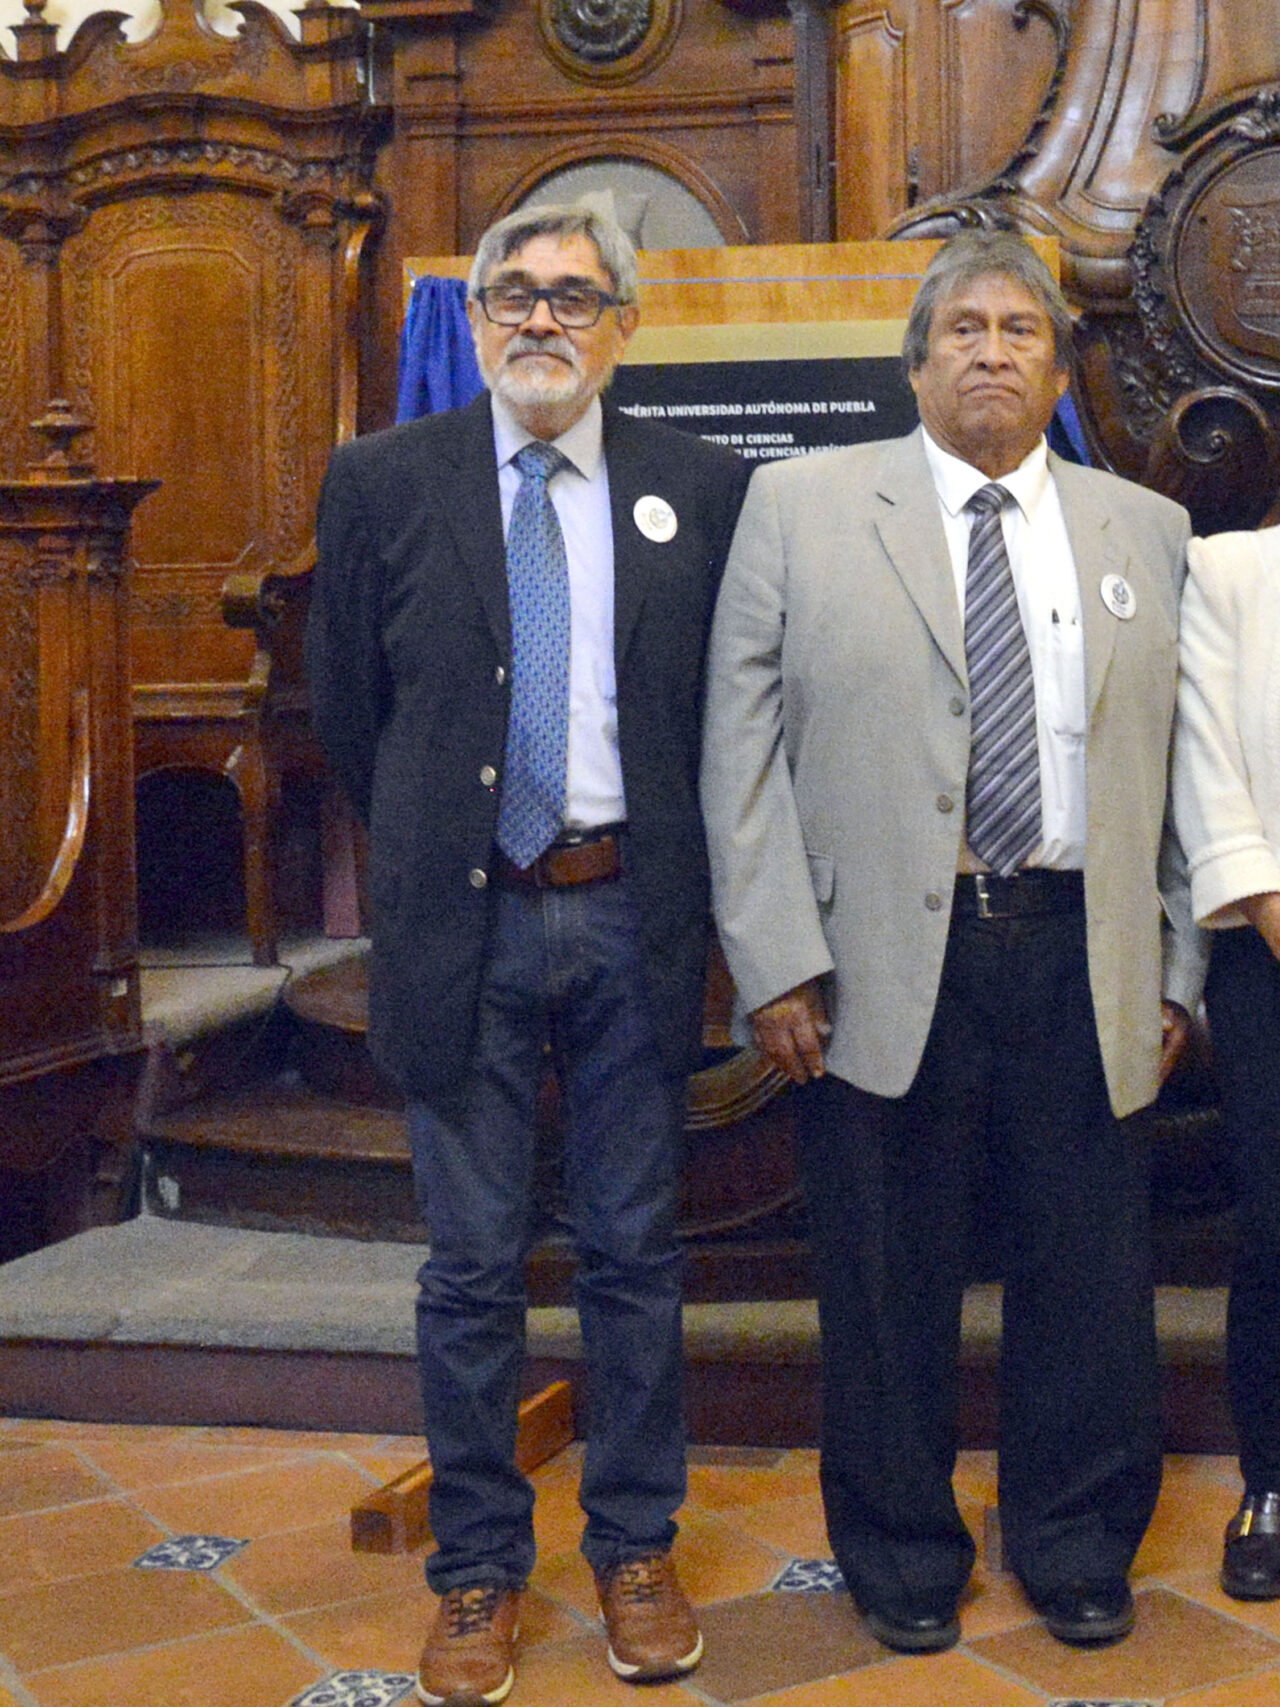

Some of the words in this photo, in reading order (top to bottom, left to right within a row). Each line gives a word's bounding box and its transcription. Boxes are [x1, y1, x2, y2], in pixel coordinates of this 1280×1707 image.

[667, 404, 744, 417] UNIVERSIDAD
[745, 401, 811, 415] AUTÓNOMA
[812, 402, 828, 413] DE
[830, 401, 876, 413] PUEBLA
[730, 434, 744, 445] DE
[746, 433, 795, 445] CIENCIAS
[743, 447, 757, 459] EN
[759, 445, 807, 458] CIENCIAS
